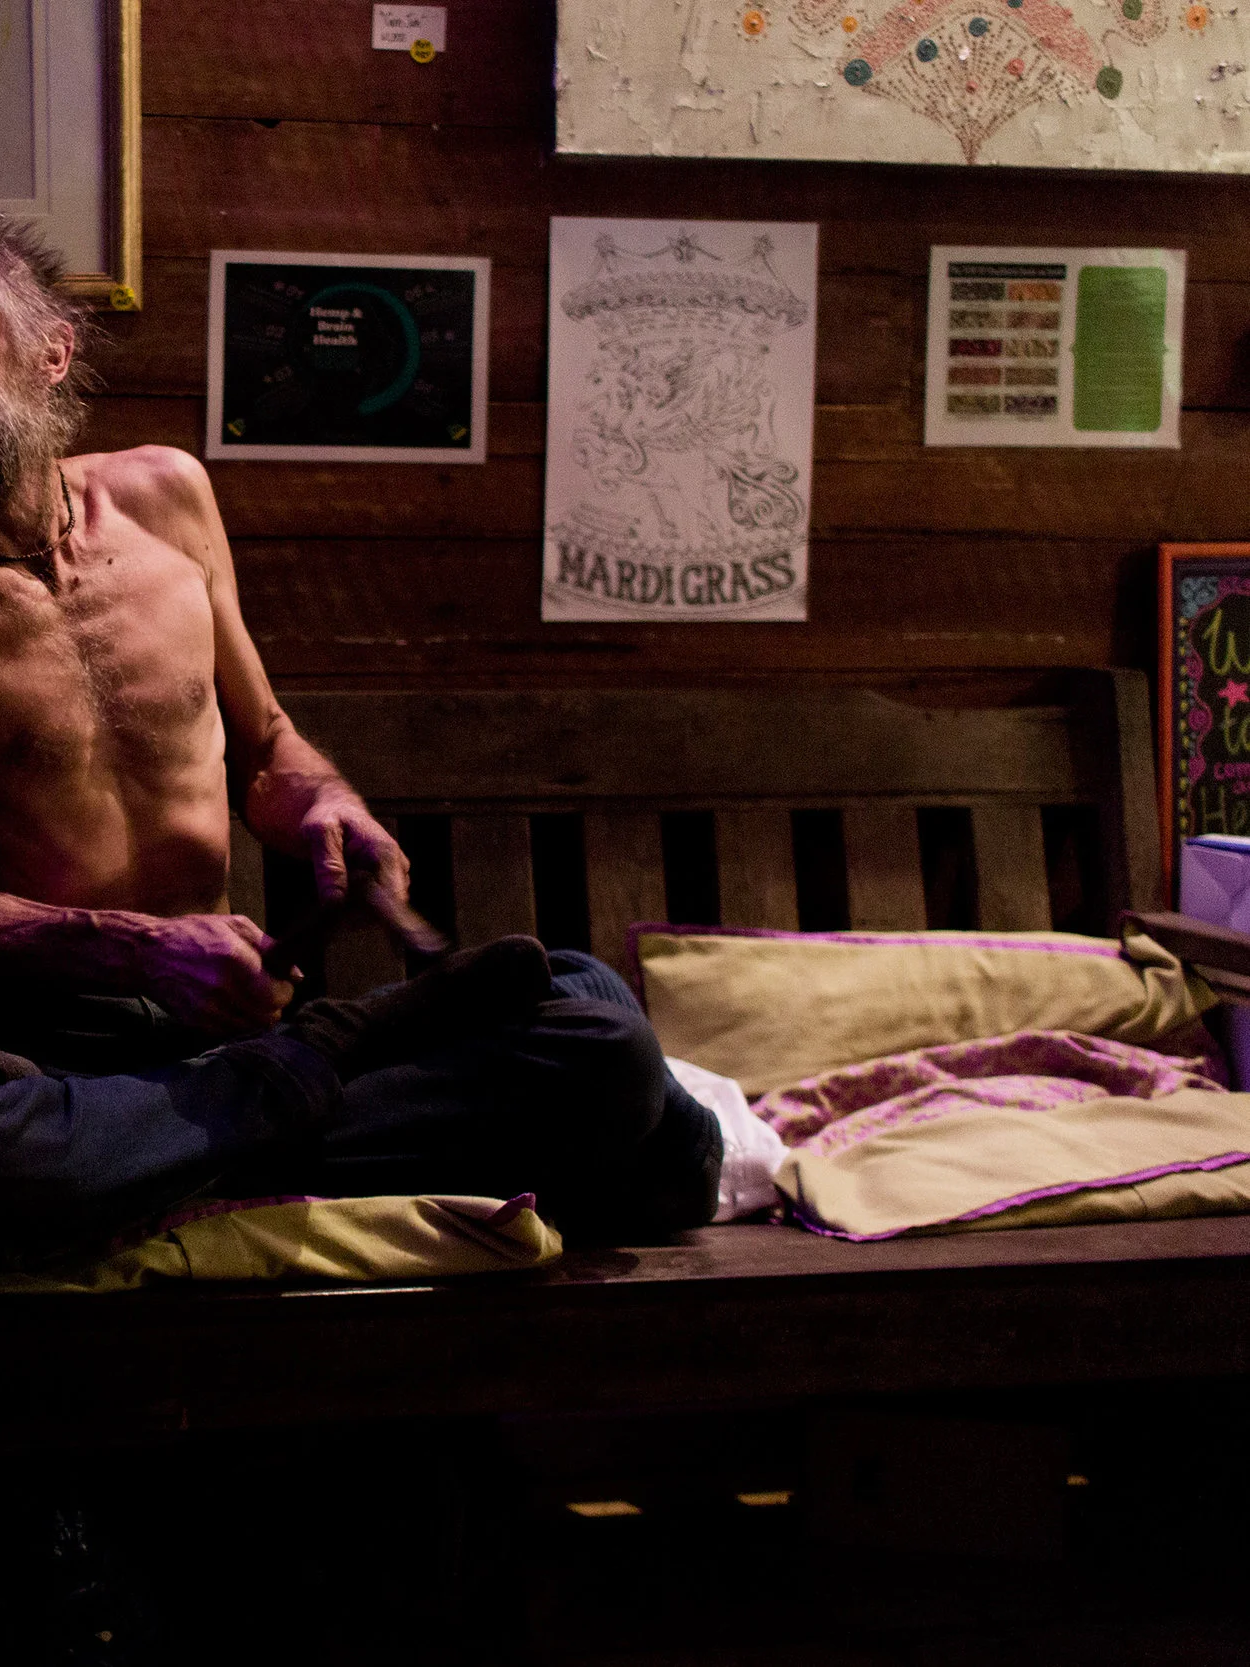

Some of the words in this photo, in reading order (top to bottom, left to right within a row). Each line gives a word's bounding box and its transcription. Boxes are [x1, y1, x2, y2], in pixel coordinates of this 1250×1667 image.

[309, 306, 351, 320] Hemp
[317, 320, 355, 332] Brain
[312, 334, 358, 346] Health
[557, 543, 676, 605] MARDI
[680, 550, 795, 605] GRASS
